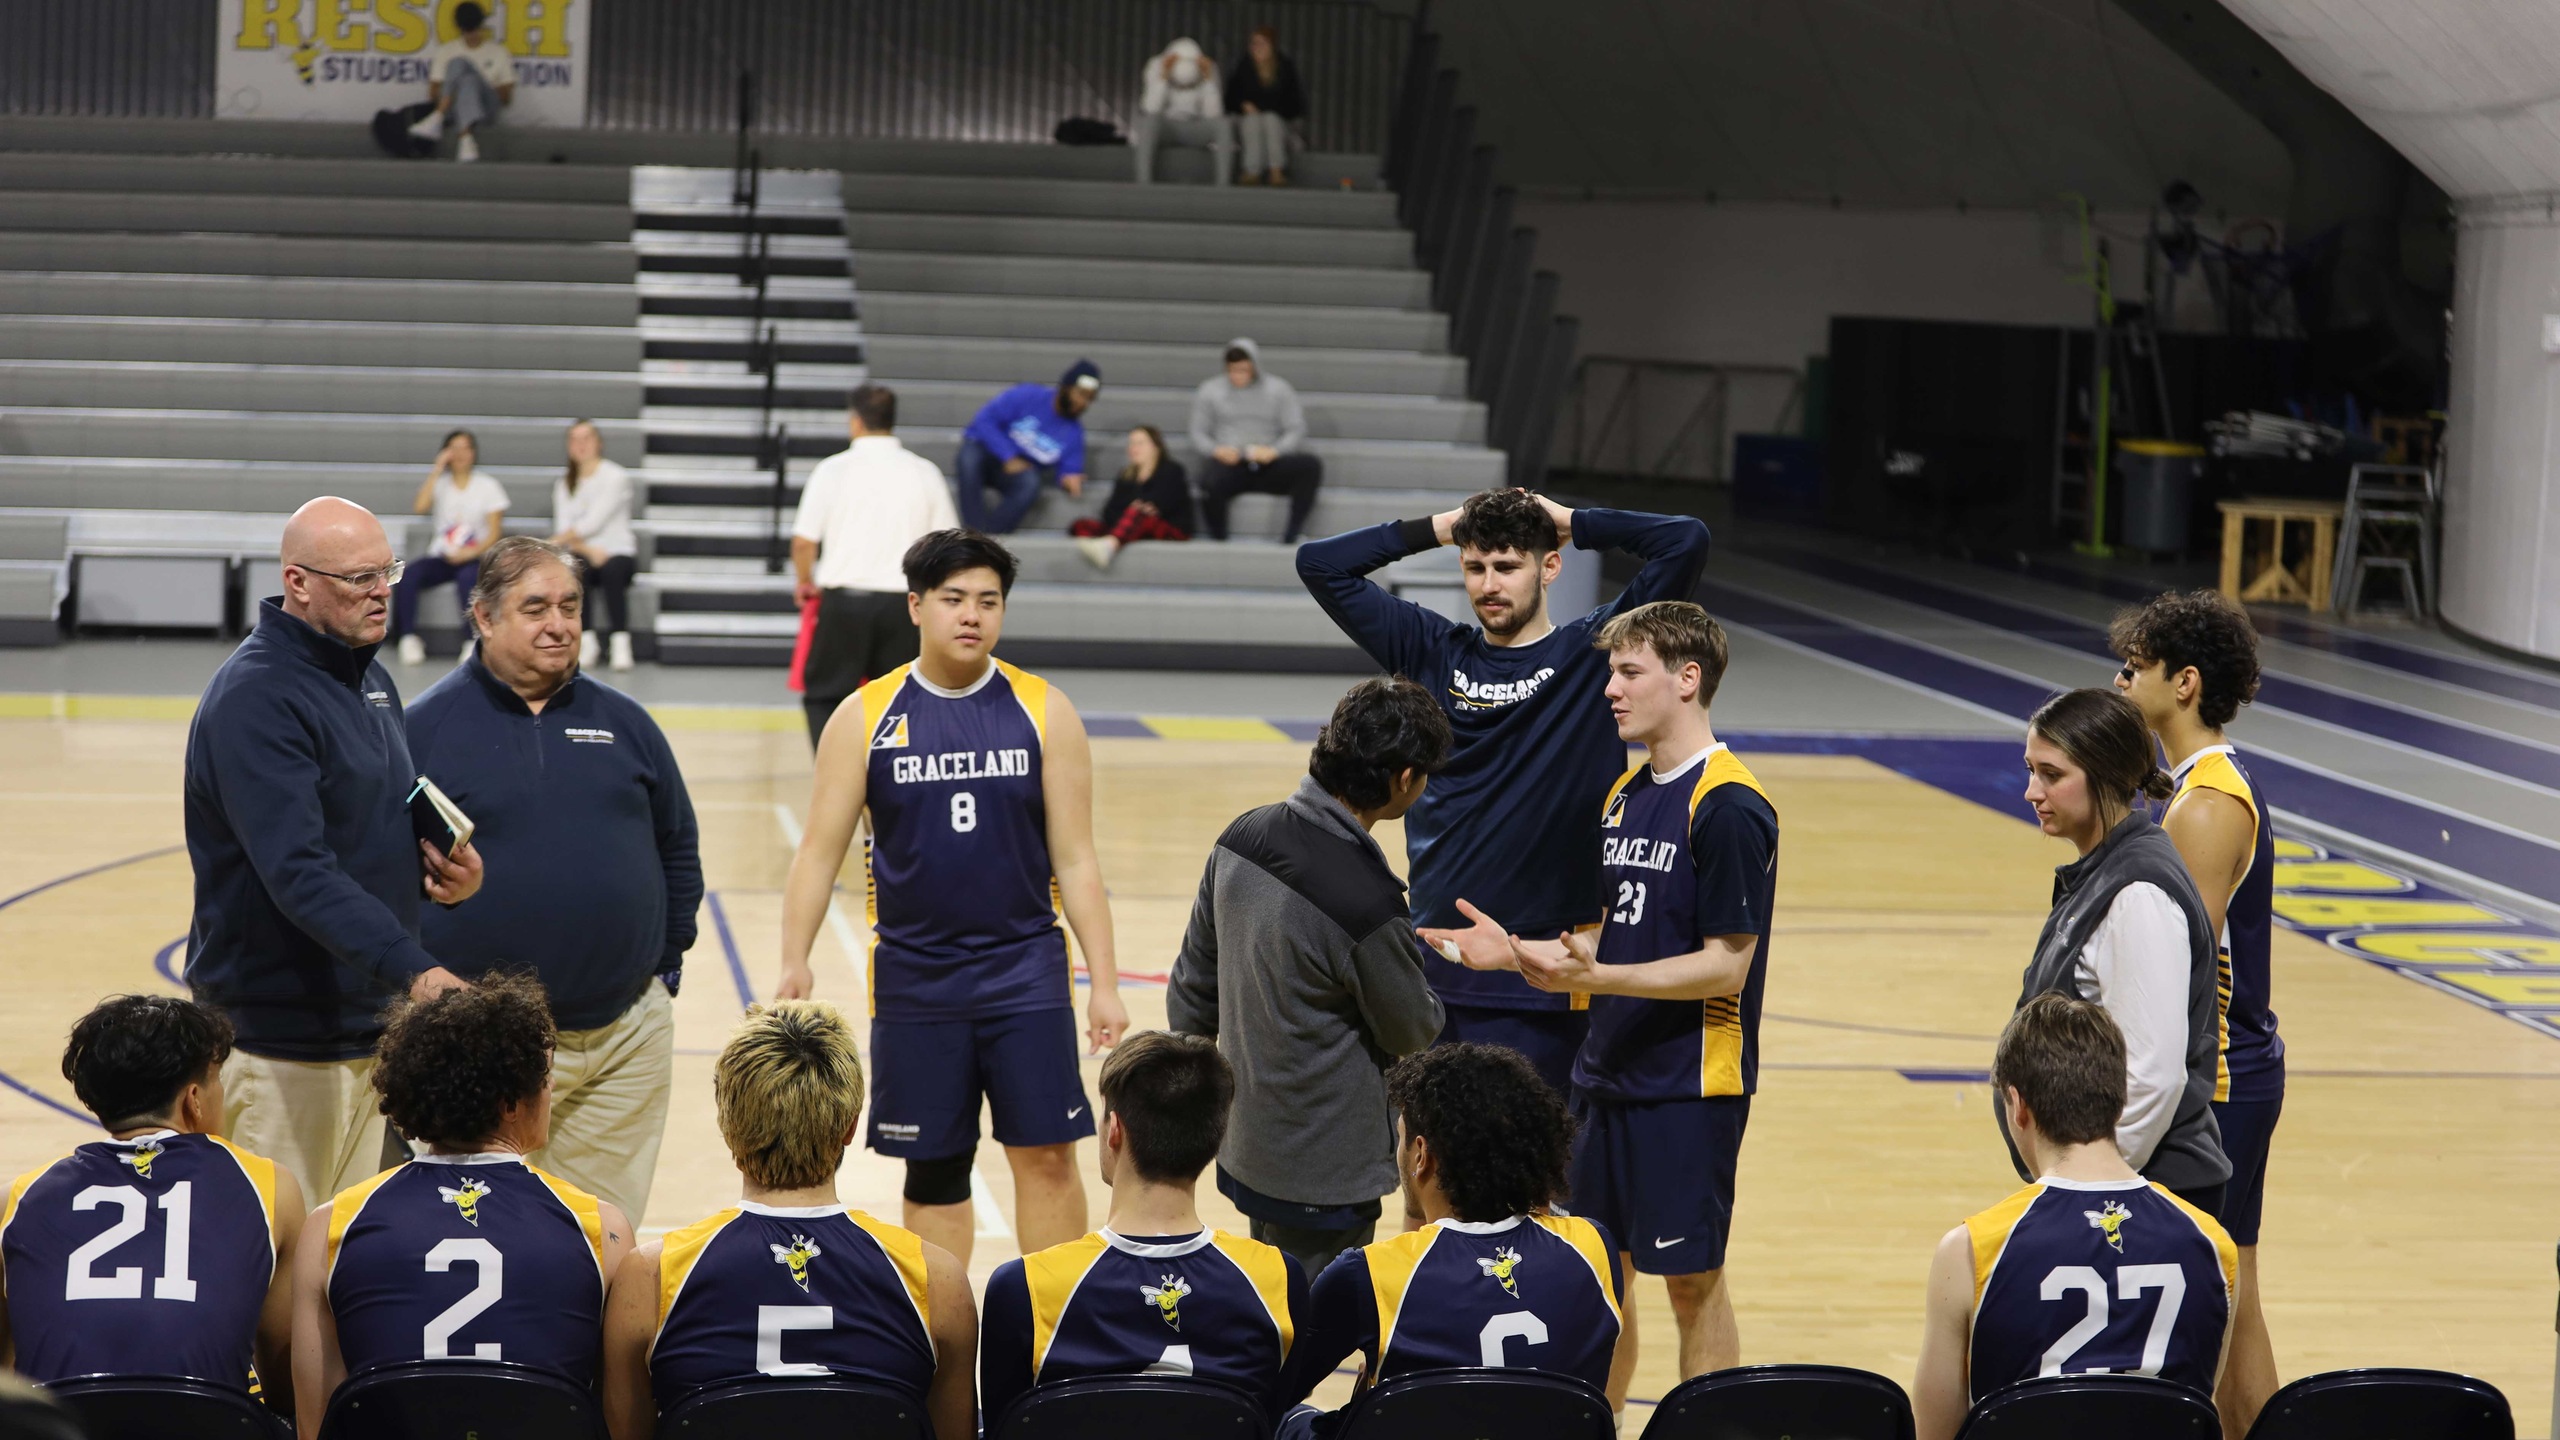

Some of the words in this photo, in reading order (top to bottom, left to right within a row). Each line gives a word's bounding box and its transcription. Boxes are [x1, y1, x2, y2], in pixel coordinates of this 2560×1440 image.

[236, 0, 571, 56] RESCH
[320, 57, 432, 84] STUDEN
[893, 749, 1029, 784] GRACELAND
[951, 792, 977, 833] 8
[1603, 837, 1678, 873] GRACEAND
[1612, 880, 1647, 926] 23
[66, 1180, 198, 1302] 21
[424, 1238, 503, 1361] 2
[2039, 1263, 2187, 1378] 27
